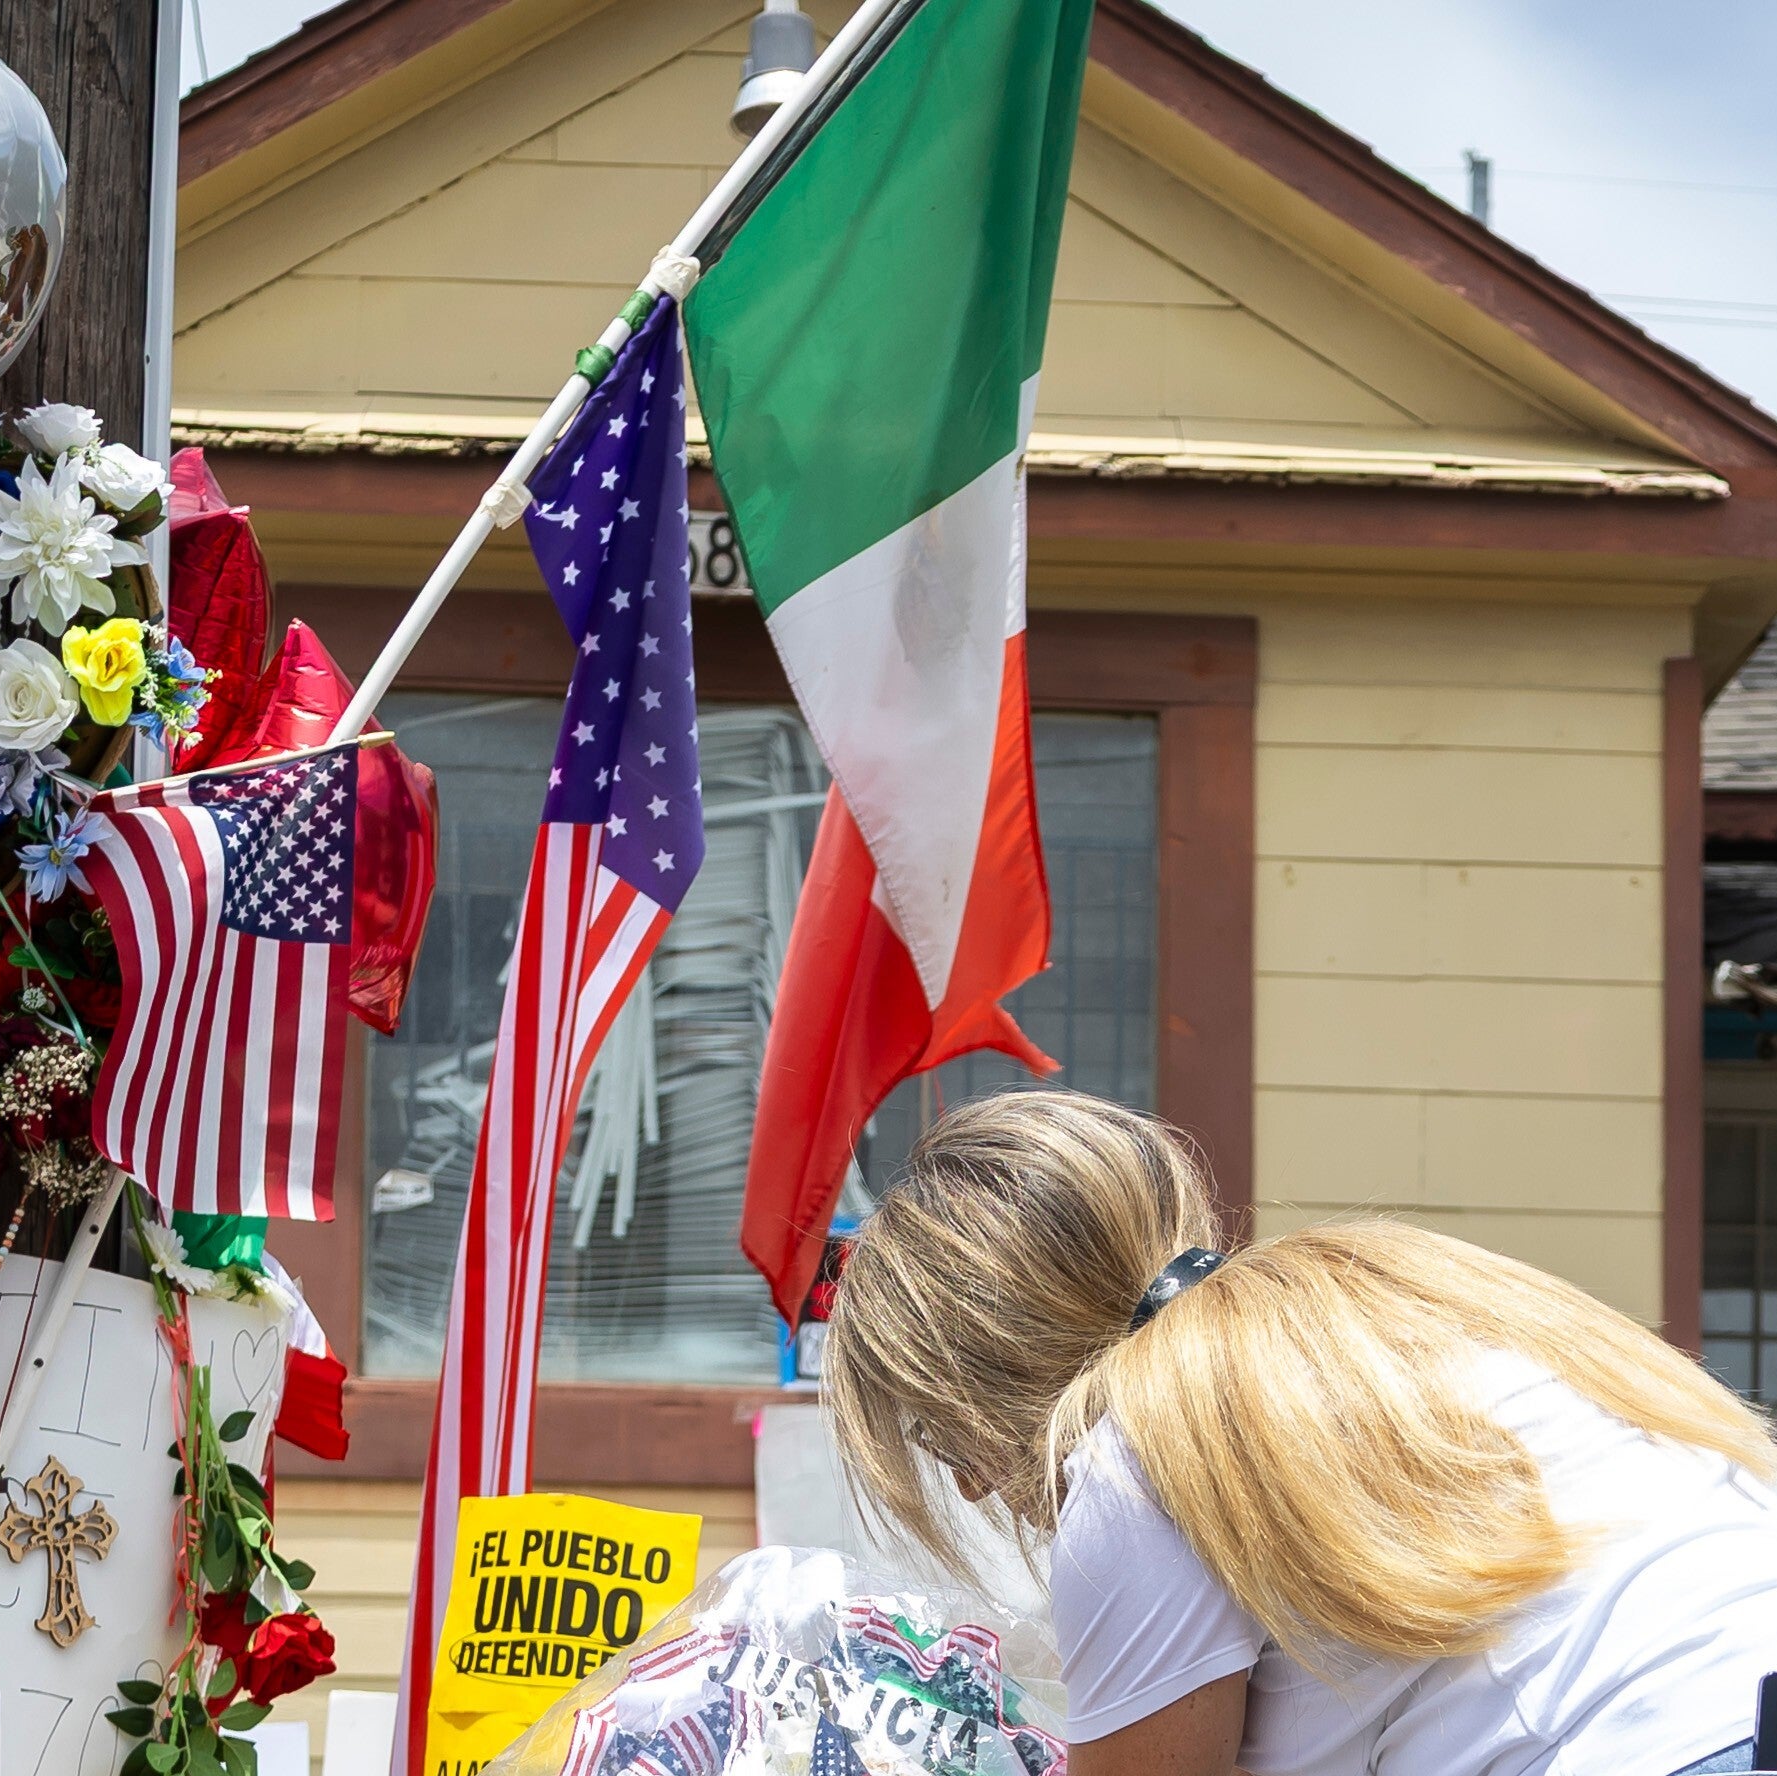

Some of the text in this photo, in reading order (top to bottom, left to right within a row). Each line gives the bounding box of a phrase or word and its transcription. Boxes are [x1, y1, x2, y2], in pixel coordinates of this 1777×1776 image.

[470, 1529, 671, 1584] ¡EL PUEBLO
[473, 1575, 644, 1647] UNIDO
